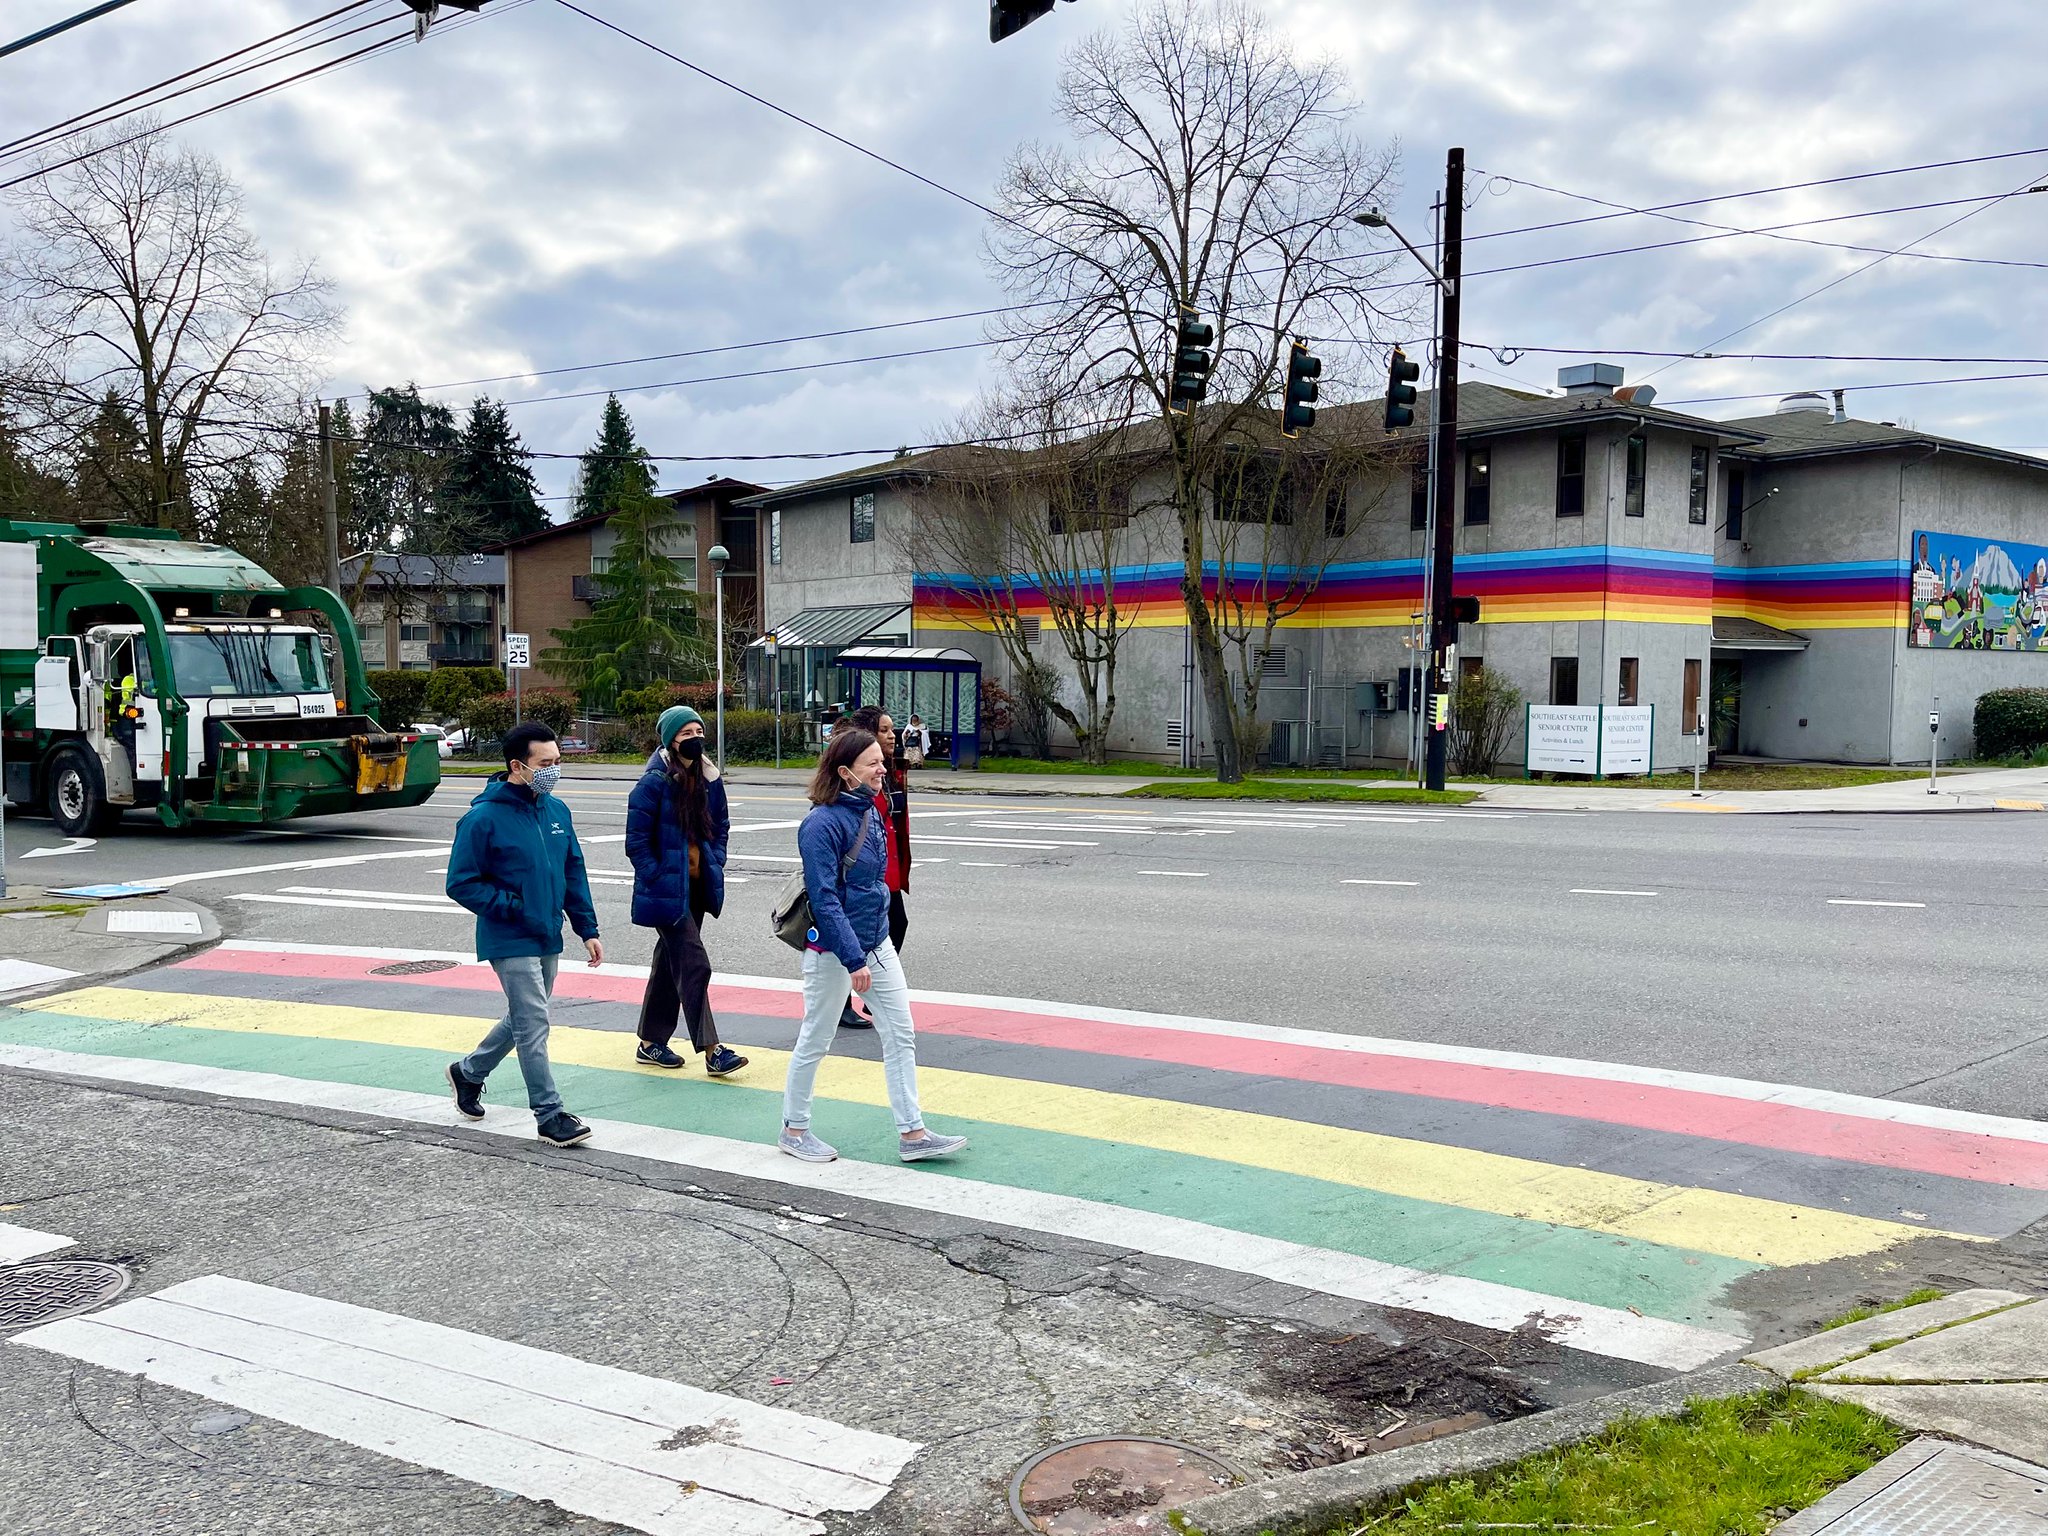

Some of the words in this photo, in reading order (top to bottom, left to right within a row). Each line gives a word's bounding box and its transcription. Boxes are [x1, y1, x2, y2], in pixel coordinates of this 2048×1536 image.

[509, 651, 527, 663] 25
[303, 705, 325, 714] 264925
[650, 1048, 662, 1060] N
